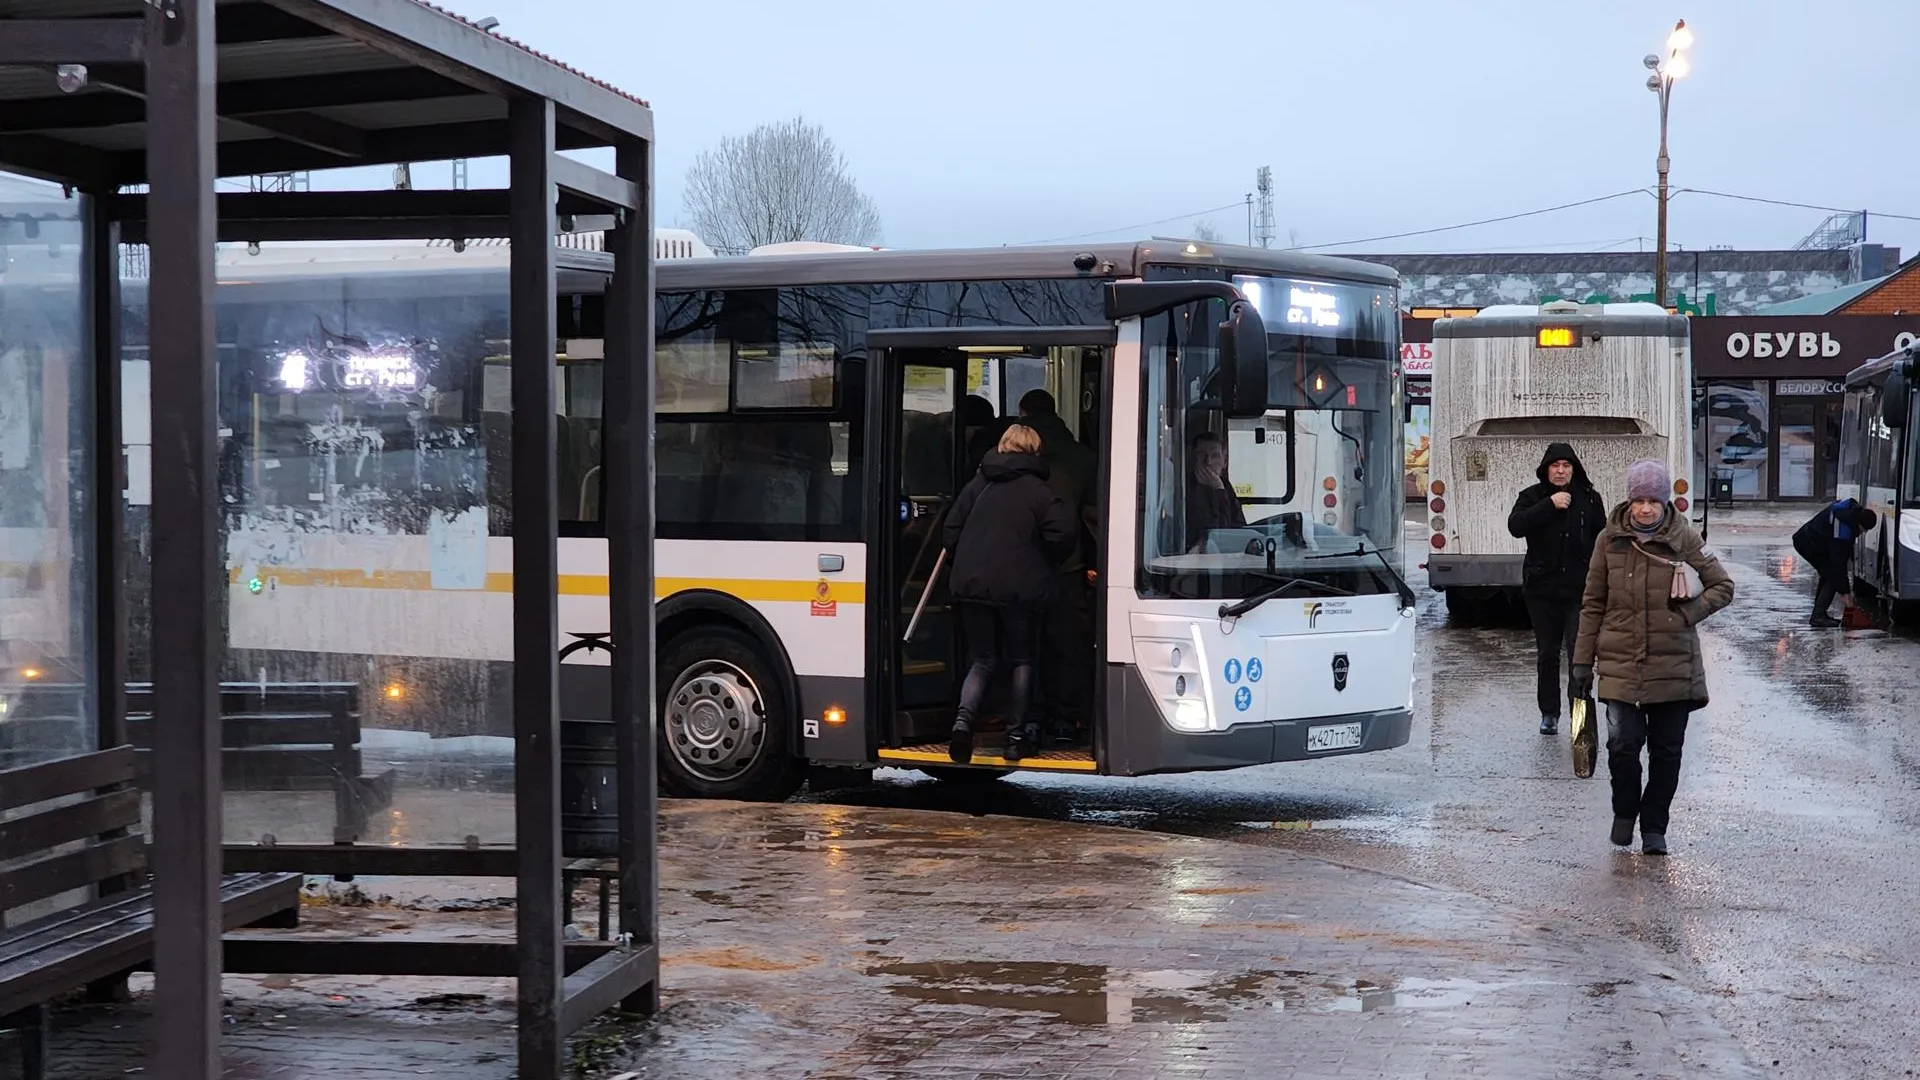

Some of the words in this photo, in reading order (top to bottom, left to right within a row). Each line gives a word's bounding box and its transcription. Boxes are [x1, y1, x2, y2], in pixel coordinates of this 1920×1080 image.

[1726, 332, 1841, 358] ОБУВЬ
[1403, 361, 1432, 369] БАС
[1780, 382, 1847, 394] БЕЛОРУССК
